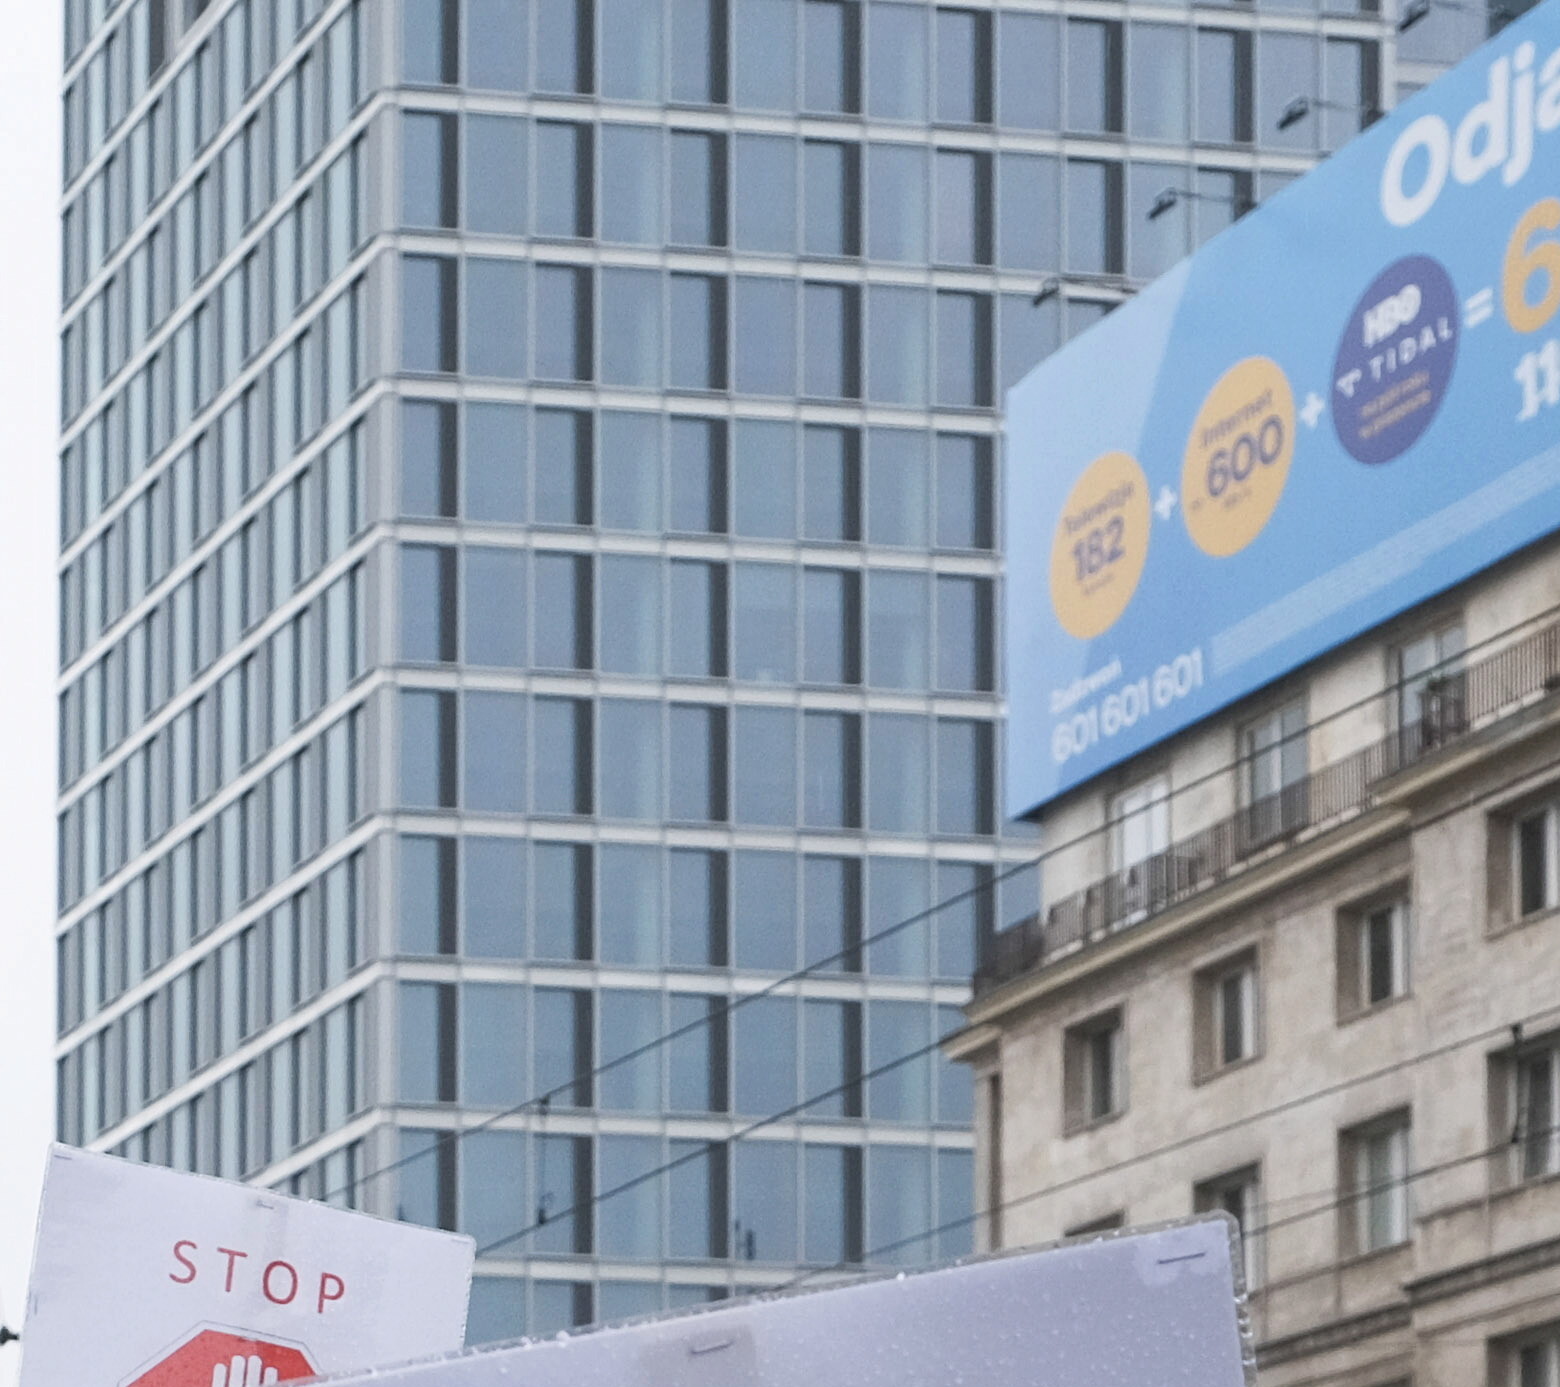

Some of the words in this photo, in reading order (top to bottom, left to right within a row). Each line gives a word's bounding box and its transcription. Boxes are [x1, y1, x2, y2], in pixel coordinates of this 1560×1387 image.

[1208, 414, 1284, 497] 600
[1072, 515, 1126, 581] 182
[1050, 705, 1099, 764] 601
[1101, 677, 1150, 736] 601
[1153, 647, 1203, 708] 601
[169, 1239, 347, 1315] STOP
